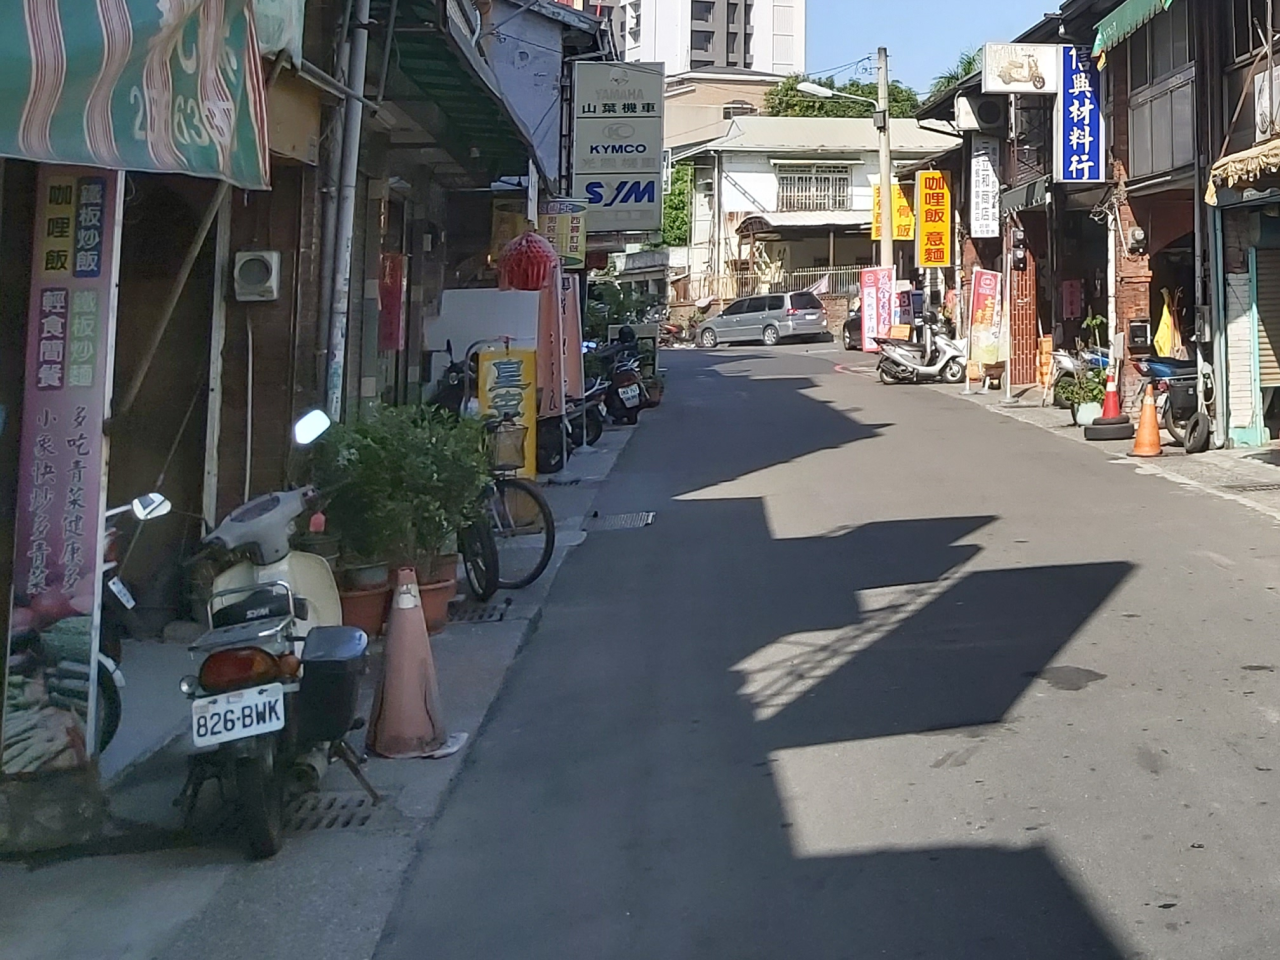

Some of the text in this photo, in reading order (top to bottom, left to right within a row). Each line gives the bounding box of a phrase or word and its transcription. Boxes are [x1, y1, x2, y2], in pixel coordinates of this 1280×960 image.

[582, 102, 657, 114] 山葉機車
[590, 144, 647, 154] KYMCO
[1068, 45, 1095, 181] 信興材料行
[44, 184, 72, 272] 咖哩飯
[75, 183, 102, 272] 鐵板炒飯
[585, 180, 656, 207] SYM
[924, 176, 946, 263] 咖哩飯 意麵
[37, 290, 66, 388] 輕食簡餐
[68, 291, 97, 387] 鐵板炒麵
[27, 408, 57, 594] 小象快炒多青菜
[61, 405, 91, 593] 多吃青菜健康多
